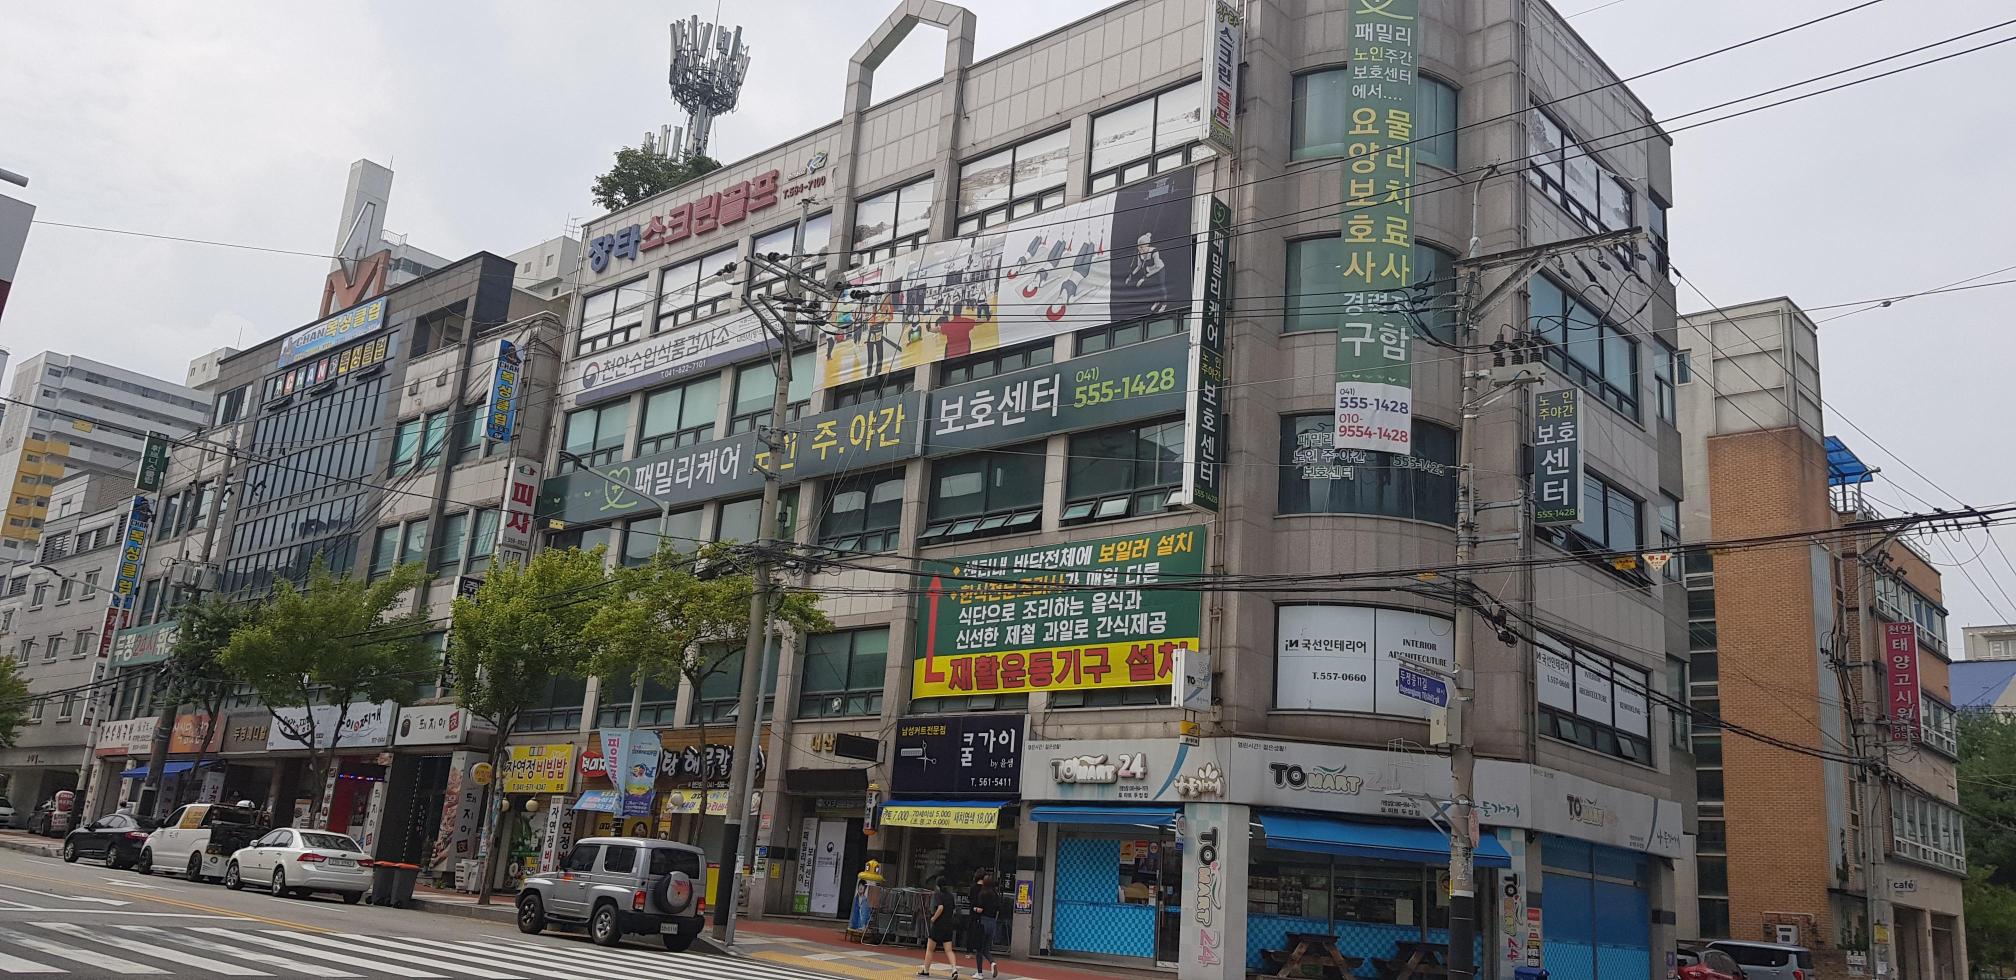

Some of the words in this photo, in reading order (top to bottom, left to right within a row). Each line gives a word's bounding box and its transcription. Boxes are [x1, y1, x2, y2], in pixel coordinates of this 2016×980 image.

[1354, 22, 1411, 47] 패밀리
[1215, 26, 1234, 130] 스크린골프
[1353, 65, 1411, 85] 보호센터
[1343, 107, 1380, 284] 요양보호사
[1380, 107, 1412, 287] 물리치료사
[1207, 230, 1224, 349] 패밀리케어
[1340, 322, 1410, 362] 구함
[602, 326, 730, 383] 천안수입식품검사소
[498, 361, 520, 373] CHAN
[1075, 366, 1099, 383] 041)
[935, 373, 1061, 436] 보호센터
[1073, 367, 1175, 409] 555-1428
[1339, 388, 1355, 396] 041)
[1339, 396, 1409, 415] 555-1428
[1539, 405, 1574, 420] 주야간
[1339, 413, 1363, 424] 010-
[1200, 380, 1217, 489] 보호센터
[1296, 432, 1334, 447] 패밀리
[1338, 425, 1408, 443] 9554-1428
[1292, 449, 1318, 464] 노인
[1392, 454, 1446, 476] 555-1428
[634, 444, 741, 497] 패밀리케어
[1301, 465, 1355, 480] 보호센터
[506, 482, 535, 534] 피자
[1537, 508, 1575, 519] 555-1428
[1013, 545, 1093, 574] 바닥전체에
[1098, 540, 1150, 563] 보일러
[1157, 531, 1194, 557] 설치
[1085, 568, 1118, 586] 매일
[1125, 561, 1161, 585] 다른
[958, 603, 1016, 627] 식단으로
[1022, 595, 1085, 620] 조리하는
[1091, 590, 1143, 613] 음식과
[955, 628, 999, 651] 신선한
[1004, 622, 1036, 646] 제철
[1042, 617, 1089, 643] 과일로
[1095, 610, 1168, 639] 간식제공
[1888, 624, 1913, 636] 천안
[1301, 638, 1367, 654] 국선인테리어
[1402, 638, 1437, 651] INTERIOR
[948, 645, 1111, 692] 재활운동기구
[1125, 640, 1189, 683] 설치
[1312, 671, 1367, 683] T.557-0660
[1892, 637, 1916, 719] 태양고시원
[901, 724, 947, 737] 남성커트전문점
[960, 728, 1016, 767] 쿨가이
[990, 758, 998, 769] by
[1118, 752, 1148, 780] 24
[979, 777, 1012, 787] 561-5411
[1472, 800, 1520, 819] 들가게
[1893, 880, 1915, 892] café
[1198, 928, 1221, 967] 24
